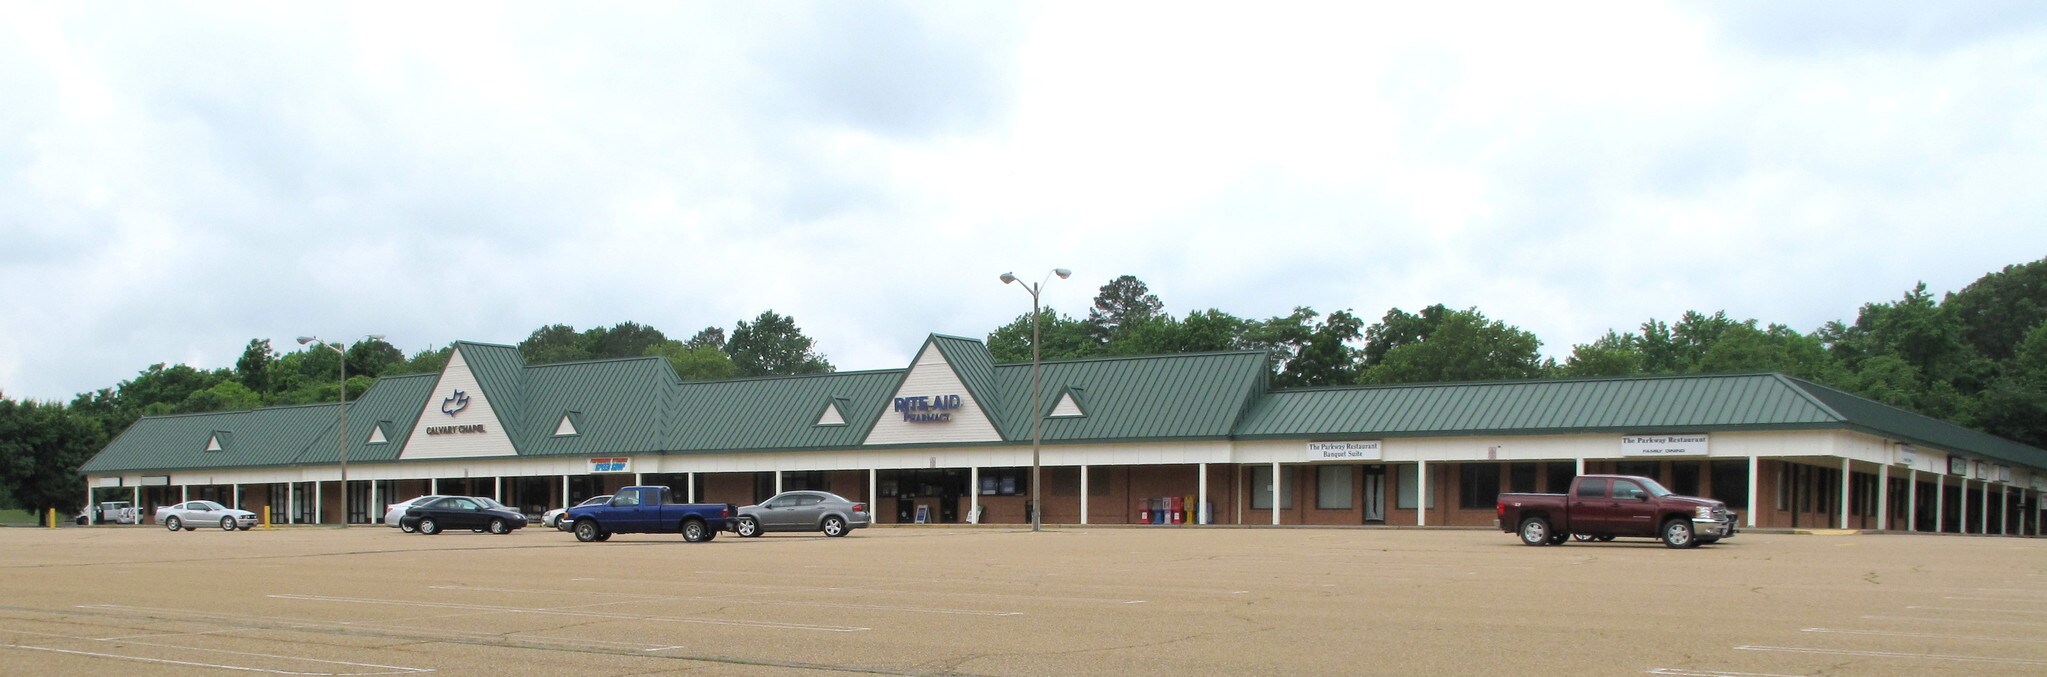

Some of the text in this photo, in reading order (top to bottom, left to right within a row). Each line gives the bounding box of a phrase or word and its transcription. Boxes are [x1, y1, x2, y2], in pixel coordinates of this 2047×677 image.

[894, 394, 961, 412] RITE AID
[903, 413, 952, 423] PHARMACY
[426, 424, 486, 435] CALVARY CHAPEL
[1321, 443, 1346, 451] Parkway
